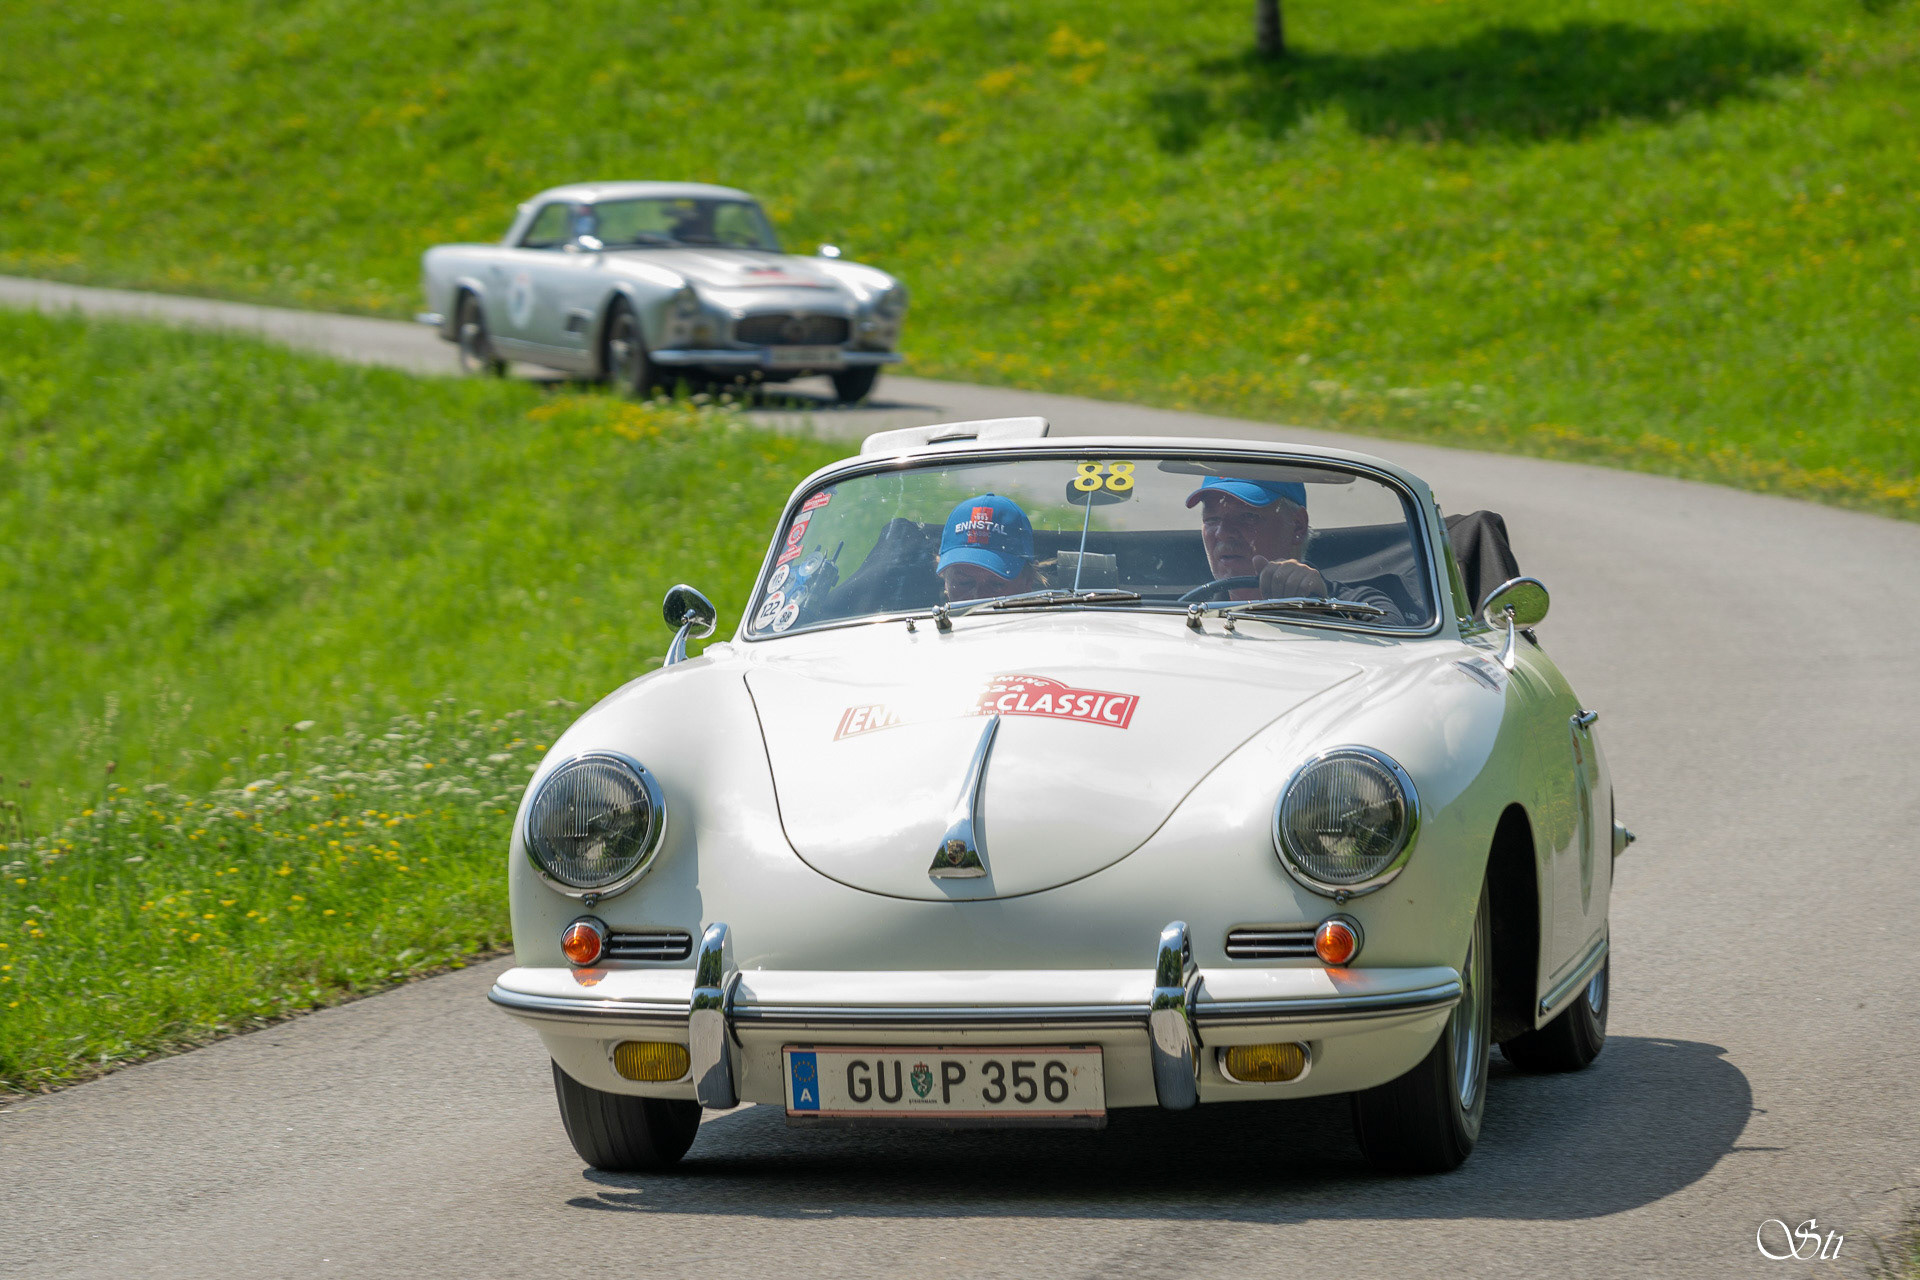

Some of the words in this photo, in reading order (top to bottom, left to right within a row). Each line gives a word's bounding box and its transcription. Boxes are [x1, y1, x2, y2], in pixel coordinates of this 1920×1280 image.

[1074, 461, 1135, 491] 88
[955, 520, 1008, 535] ENNSTAL
[760, 600, 780, 618] 122
[846, 1060, 903, 1104] GU
[941, 1061, 966, 1104] P
[981, 1060, 1069, 1104] 356
[800, 1088, 813, 1102] A
